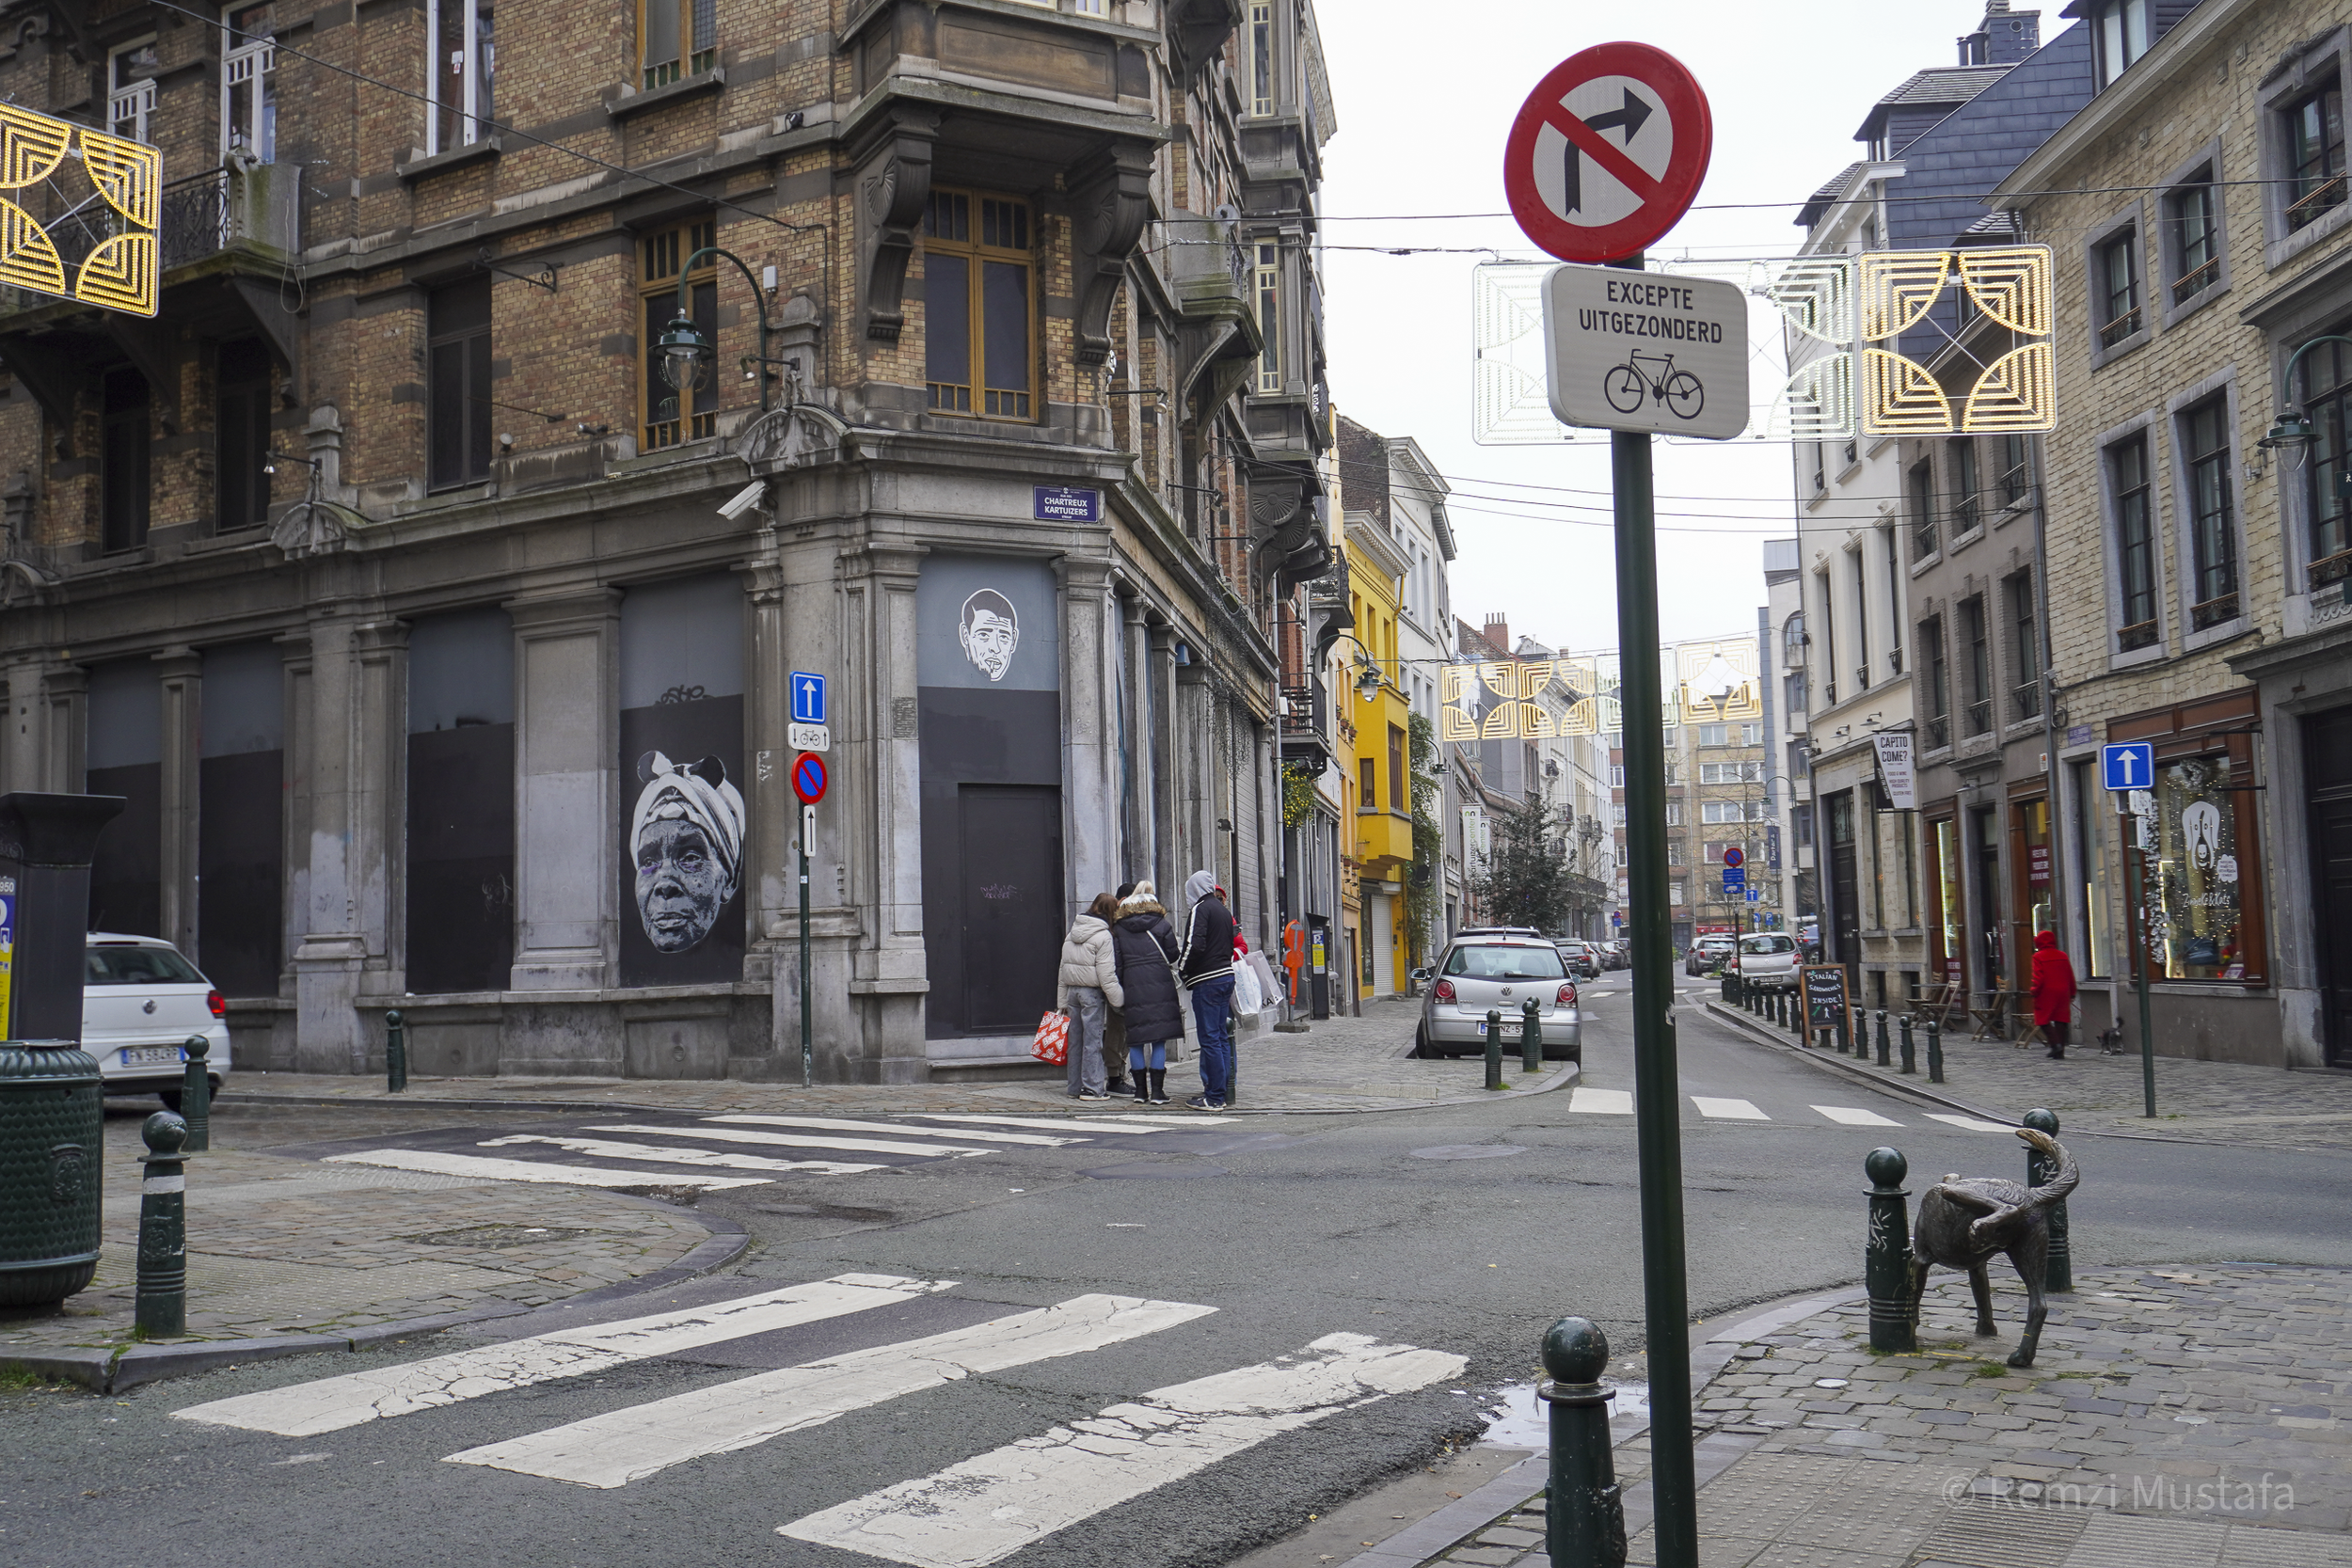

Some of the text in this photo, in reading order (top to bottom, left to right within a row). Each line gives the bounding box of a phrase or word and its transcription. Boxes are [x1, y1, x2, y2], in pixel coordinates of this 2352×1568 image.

[1607, 280, 1693, 309] EXCEPTE
[1579, 309, 1722, 343] UITGEZONDERD
[1044, 497, 1088, 508] CHARTREUX
[1044, 505, 1089, 516] KARTUIZERS
[1881, 736, 1908, 748] CAPITO
[1882, 751, 1908, 763] COME?
